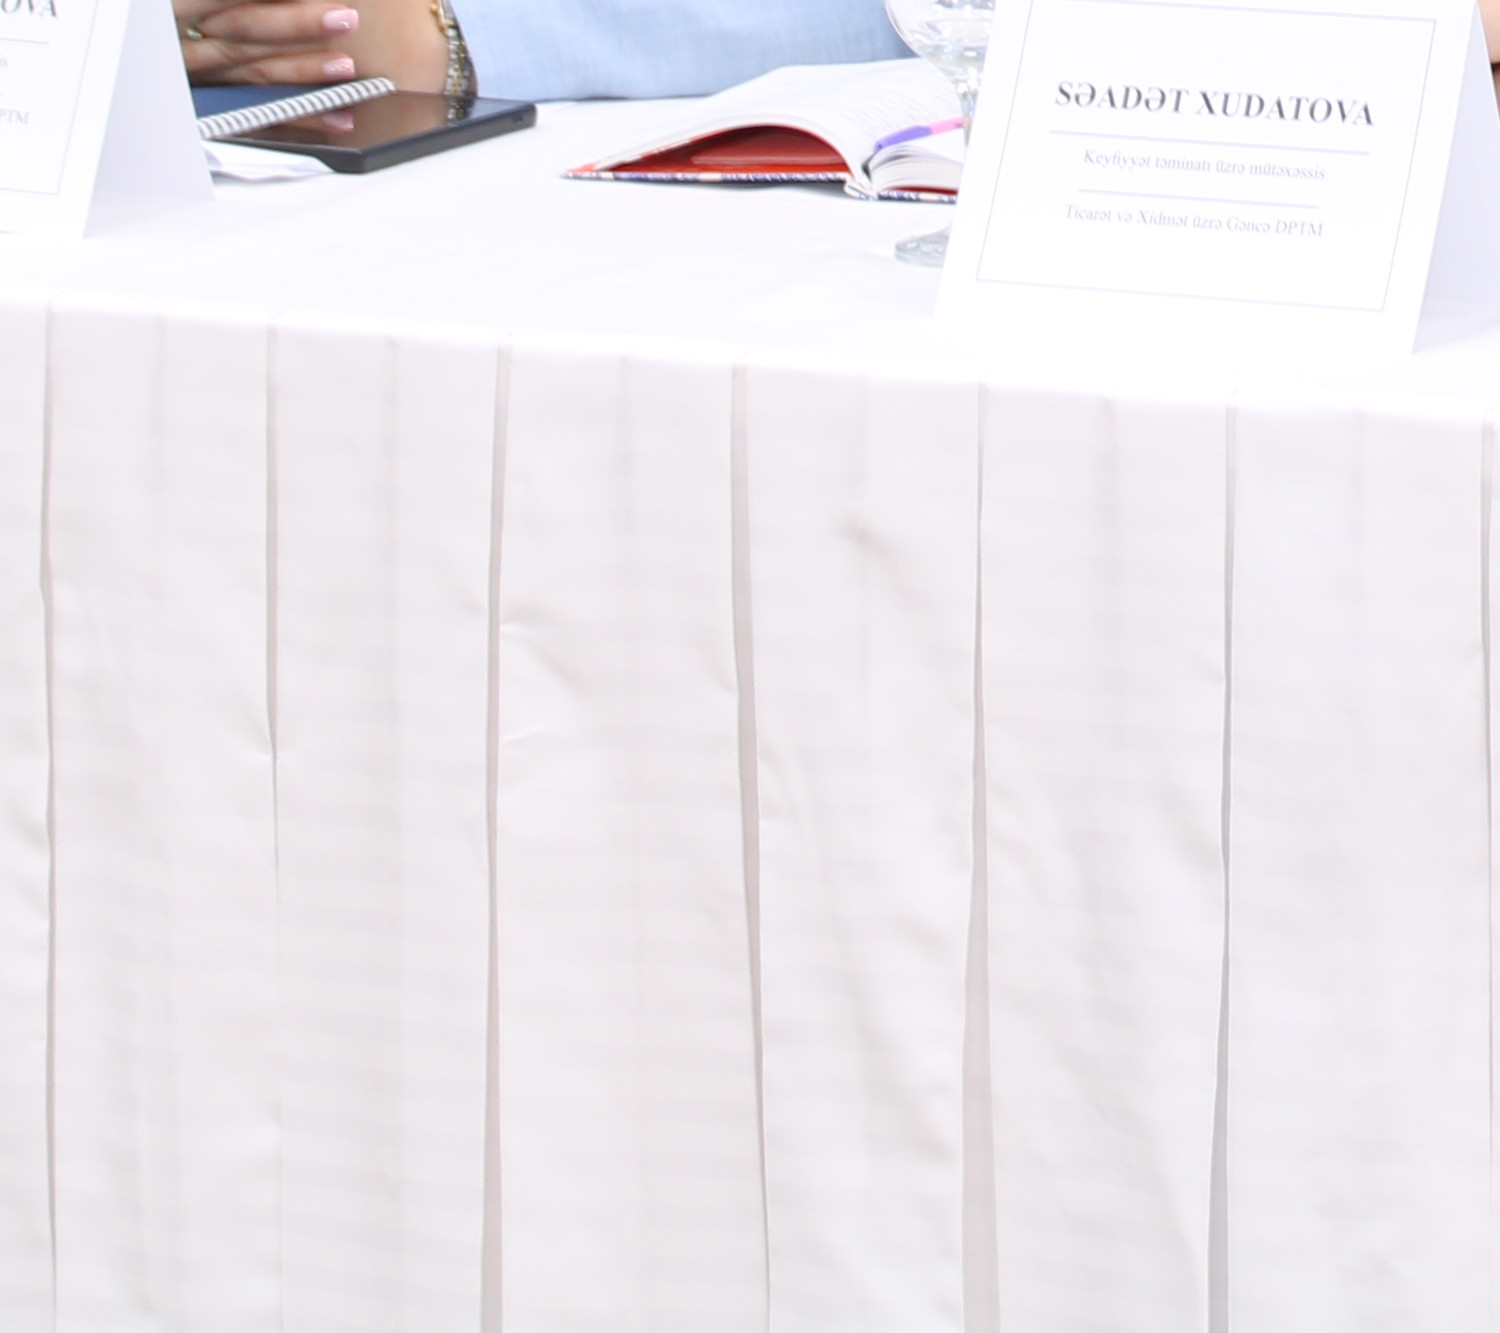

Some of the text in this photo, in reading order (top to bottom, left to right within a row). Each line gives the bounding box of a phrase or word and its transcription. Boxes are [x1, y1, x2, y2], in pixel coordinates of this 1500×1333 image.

[1055, 81, 1374, 126] SƏADƏT XUDATOVA
[1084, 149, 1325, 180] Keyfiyyət təminatı üzrə mütəxəssis
[1065, 204, 1323, 237] Ticarət və Xidmət üzrə Gəncə DPTM
